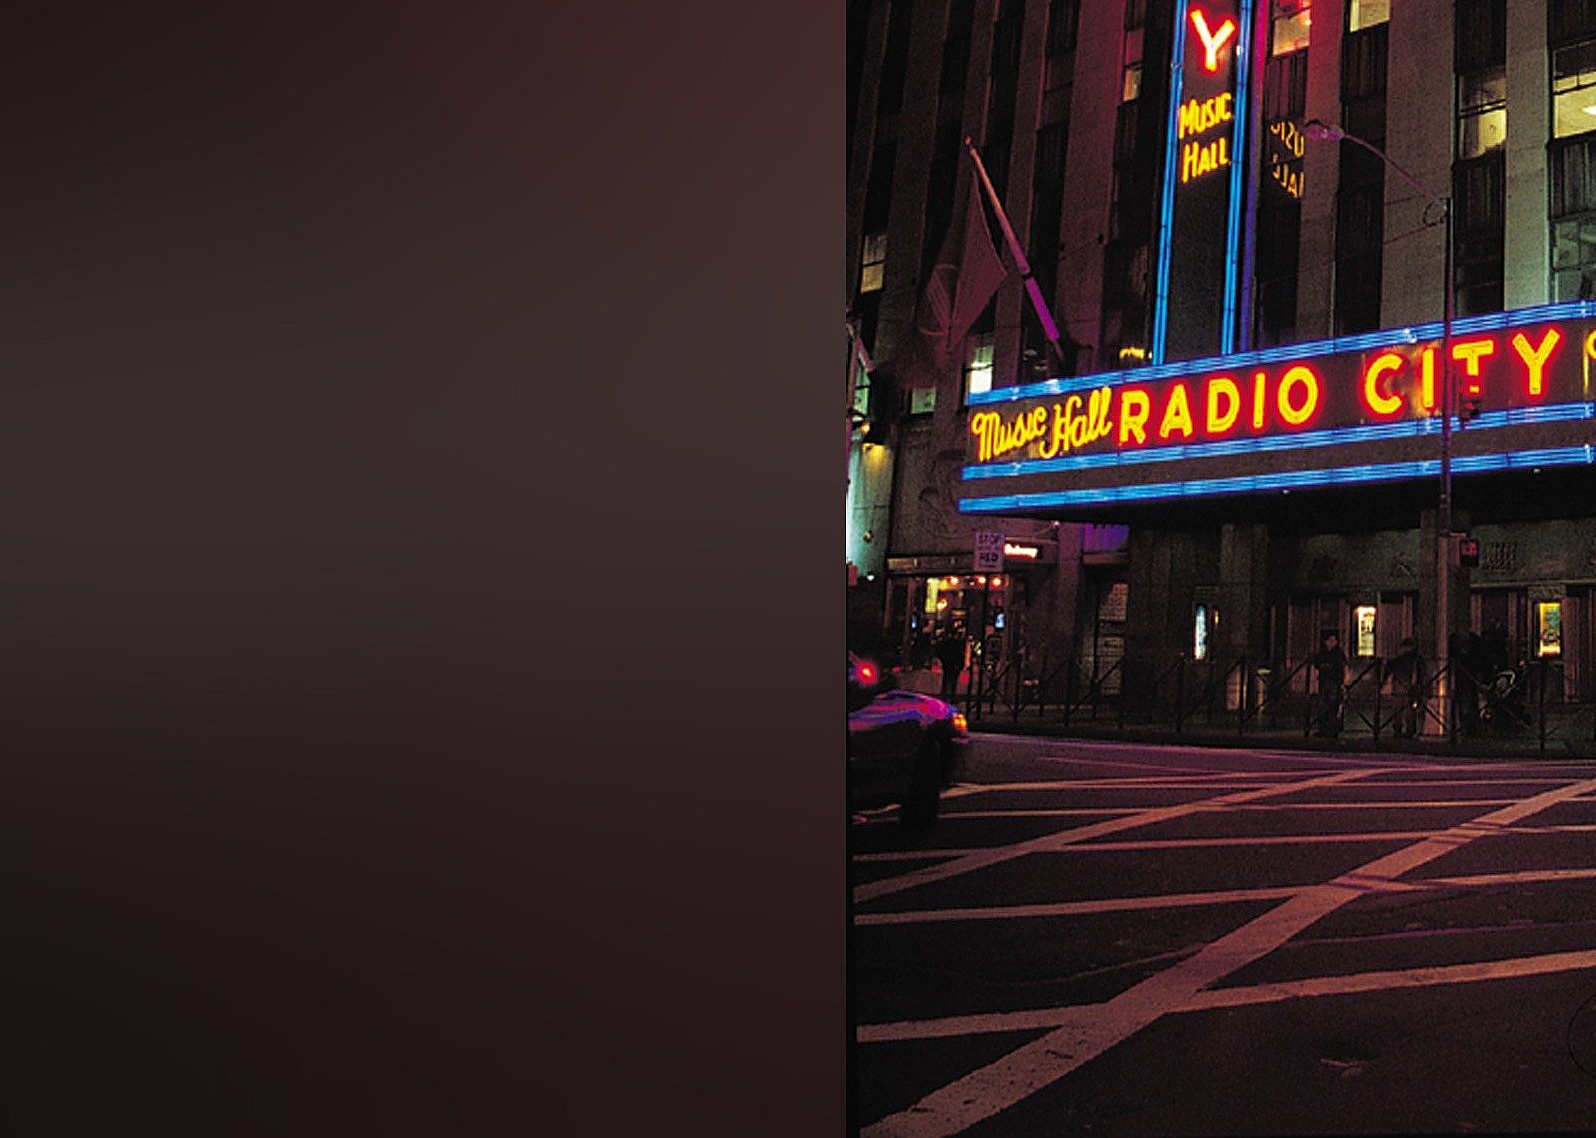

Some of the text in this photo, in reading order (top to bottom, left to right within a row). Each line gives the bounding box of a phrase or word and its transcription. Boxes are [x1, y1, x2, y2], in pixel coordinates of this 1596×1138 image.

[970, 406, 1049, 462] Music
[1038, 386, 1114, 459] Hall
[1119, 365, 1319, 444] RADIO
[1364, 328, 1561, 415] CITY
